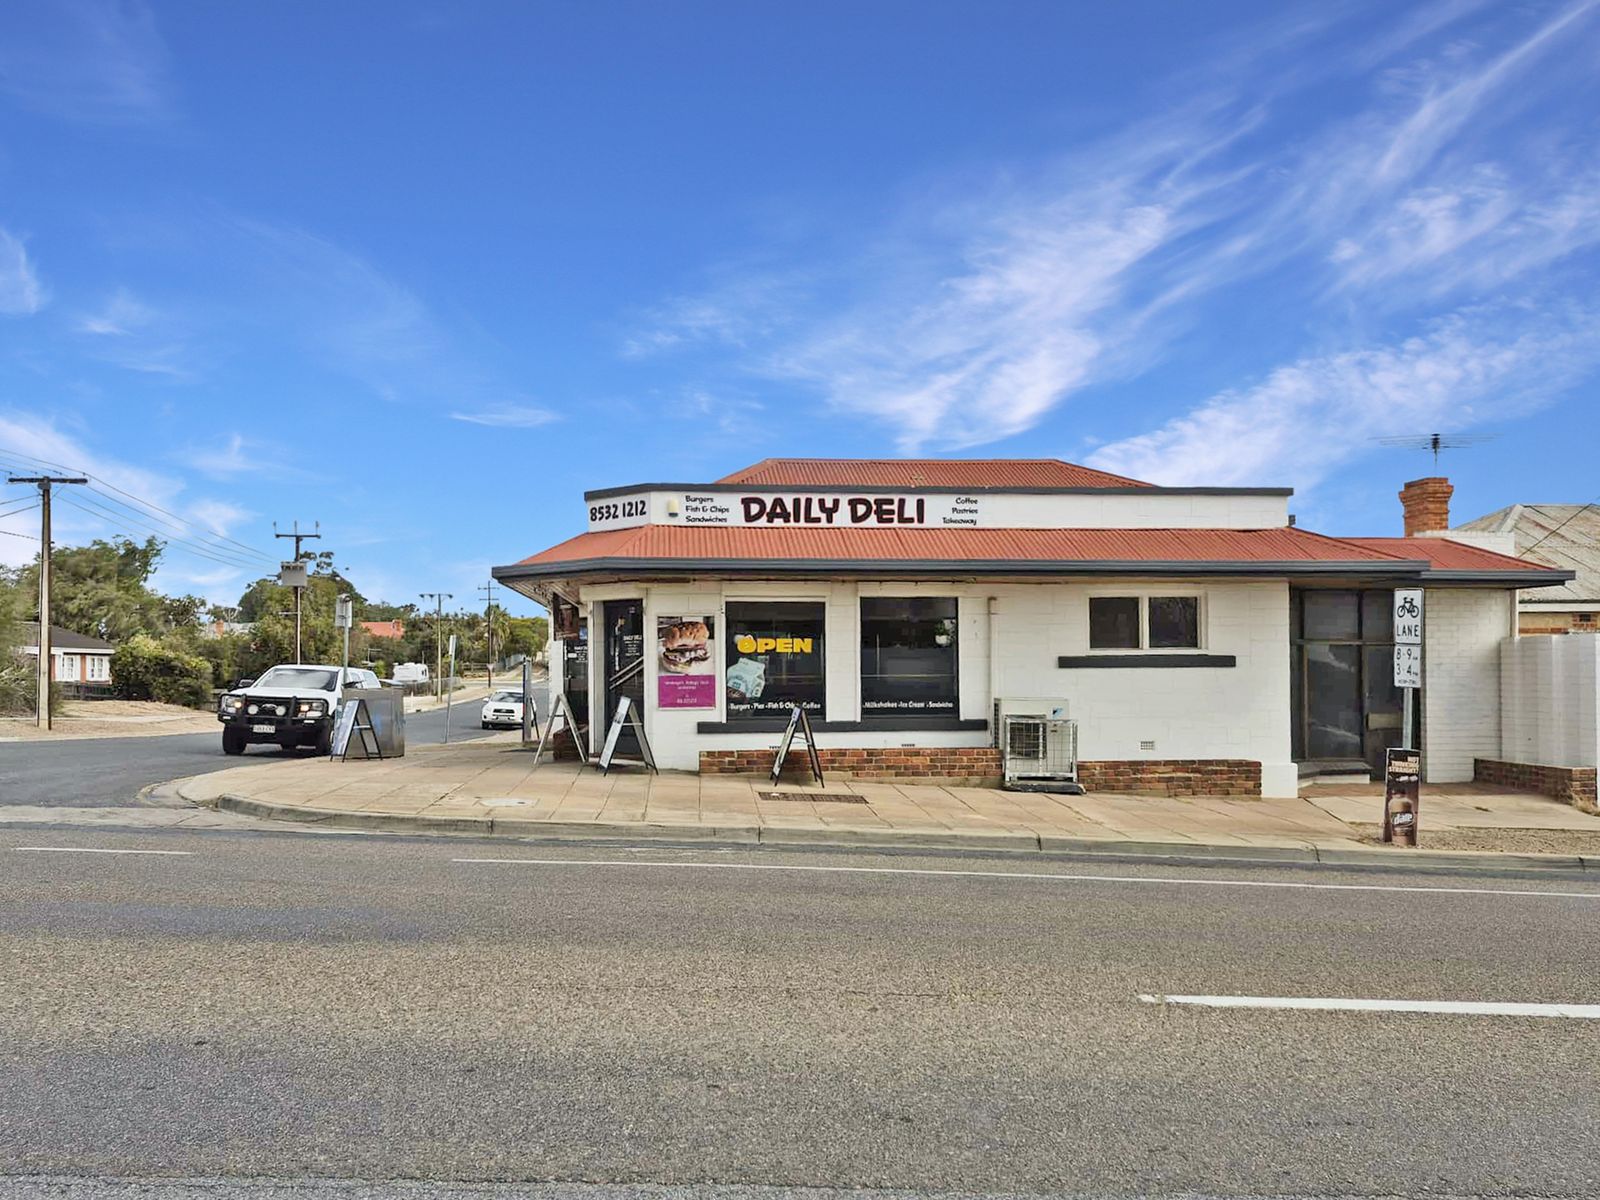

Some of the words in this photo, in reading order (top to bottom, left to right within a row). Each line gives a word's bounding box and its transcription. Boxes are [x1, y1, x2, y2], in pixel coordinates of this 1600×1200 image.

[685, 495, 714, 504] Burgers
[590, 504, 619, 522] 8532
[622, 500, 647, 518] 1212
[709, 505, 730, 514] Chips
[740, 497, 840, 523] DAILY
[848, 498, 925, 524] DELI
[685, 515, 727, 523] Sandwiches
[942, 517, 977, 526] Takeaway
[1396, 624, 1419, 637] LANE
[737, 637, 814, 654] OPEN
